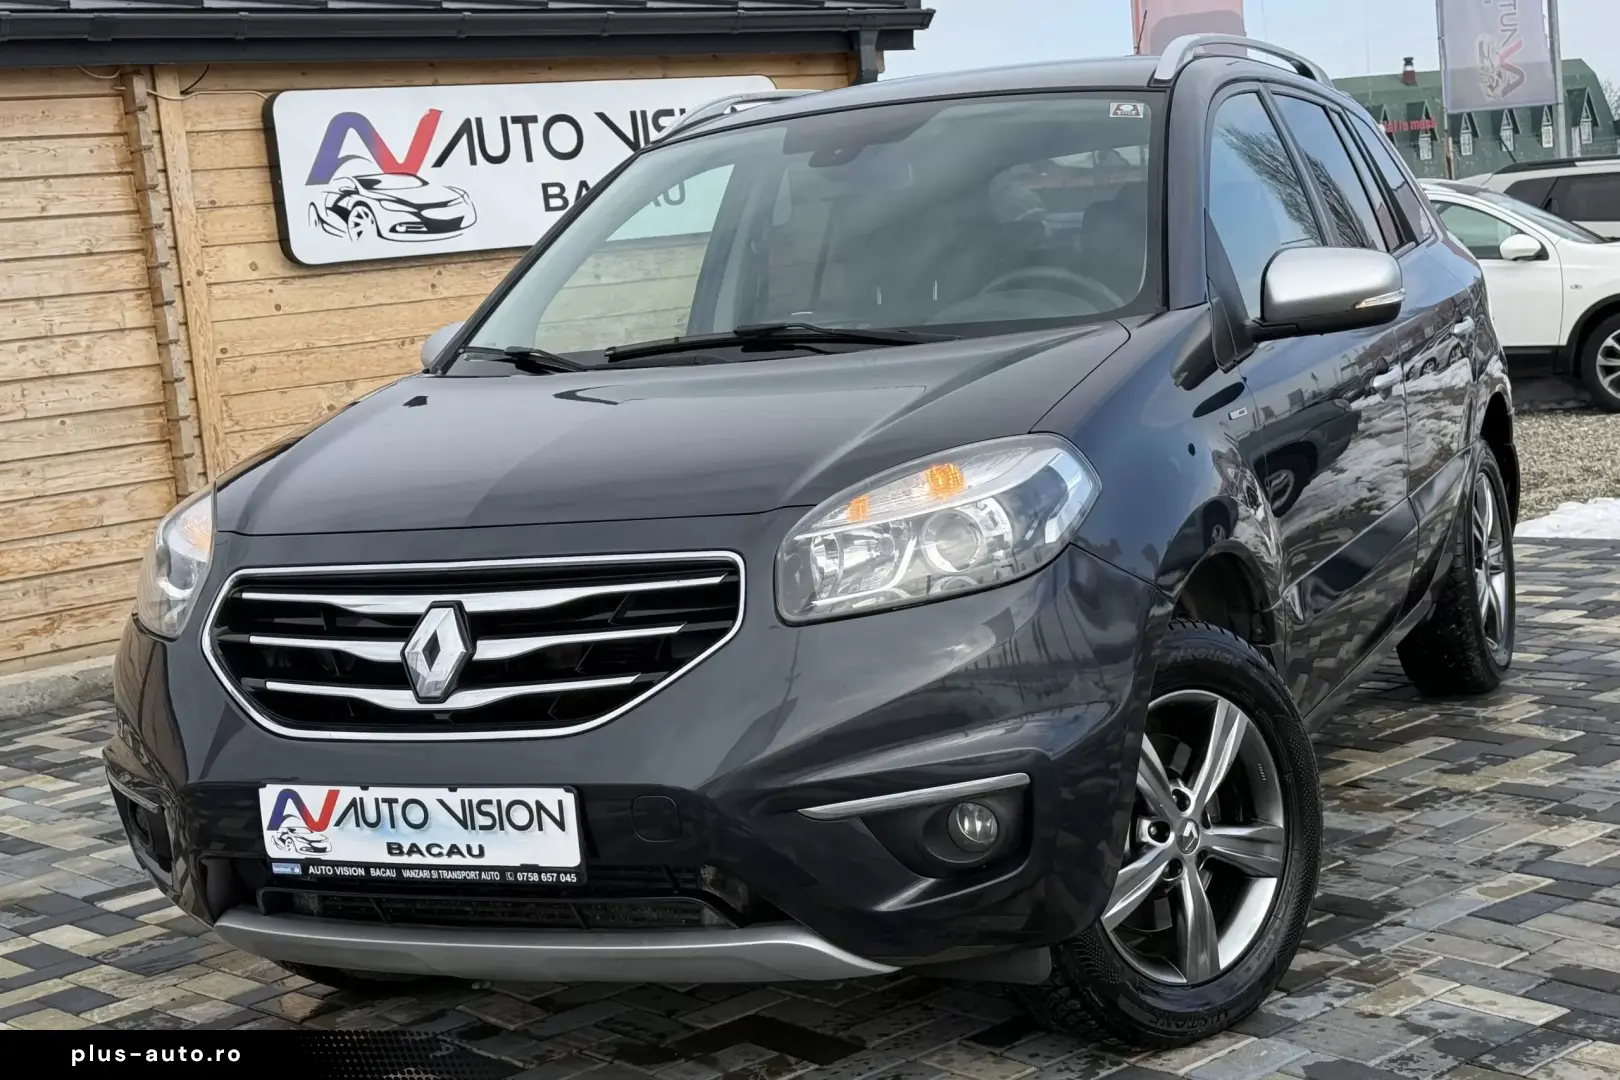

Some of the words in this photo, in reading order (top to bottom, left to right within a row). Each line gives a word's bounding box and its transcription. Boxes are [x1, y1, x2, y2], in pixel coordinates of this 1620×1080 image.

[431, 112, 585, 168] AUTO
[333, 796, 430, 830] AUTO
[436, 798, 567, 833] VISION
[386, 841, 486, 859] BACAU
[308, 865, 333, 876] AUTO
[334, 866, 365, 877] VISION
[370, 867, 396, 878] BACAU
[401, 868, 431, 879] VANZARI
[439, 870, 481, 880] TRANSPORT
[481, 871, 500, 881] AUTO
[517, 872, 539, 882] 0758
[541, 873, 558, 883] 657
[559, 874, 577, 883] 045
